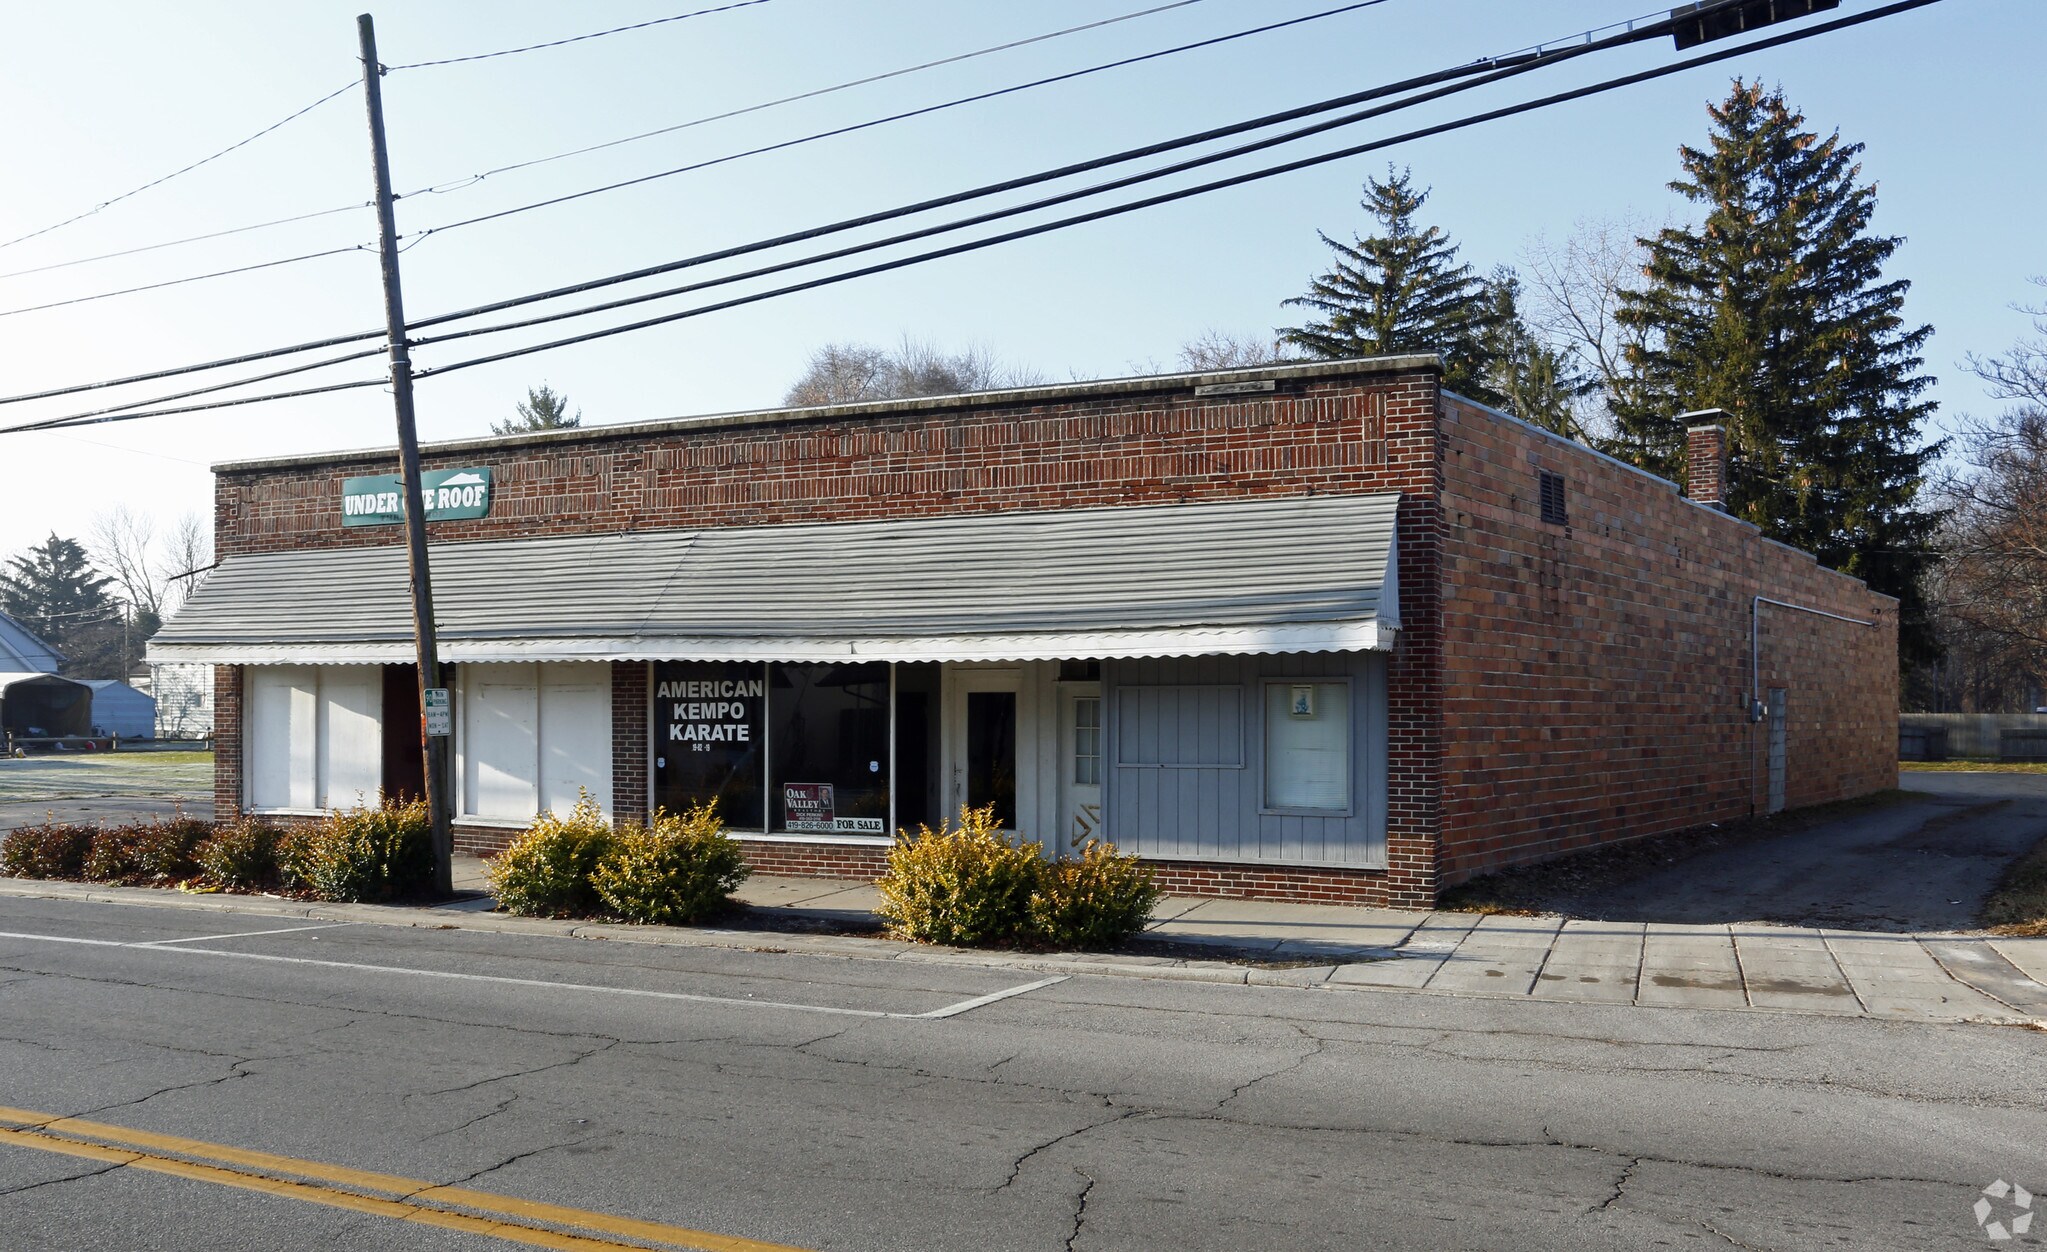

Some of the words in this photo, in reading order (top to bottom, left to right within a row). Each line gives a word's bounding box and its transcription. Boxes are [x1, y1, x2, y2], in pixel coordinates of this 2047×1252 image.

[345, 492, 398, 515] UNDER
[438, 485, 485, 508] ROOF
[657, 680, 762, 698] AMERICAN
[673, 702, 744, 720] KEMPO
[669, 723, 749, 741] KARATE
[786, 788, 806, 799] OAK
[786, 799, 819, 809] VALLEY
[788, 821, 833, 829] 419-826-6000
[837, 819, 854, 829] FOR
[858, 820, 881, 830] SALE
